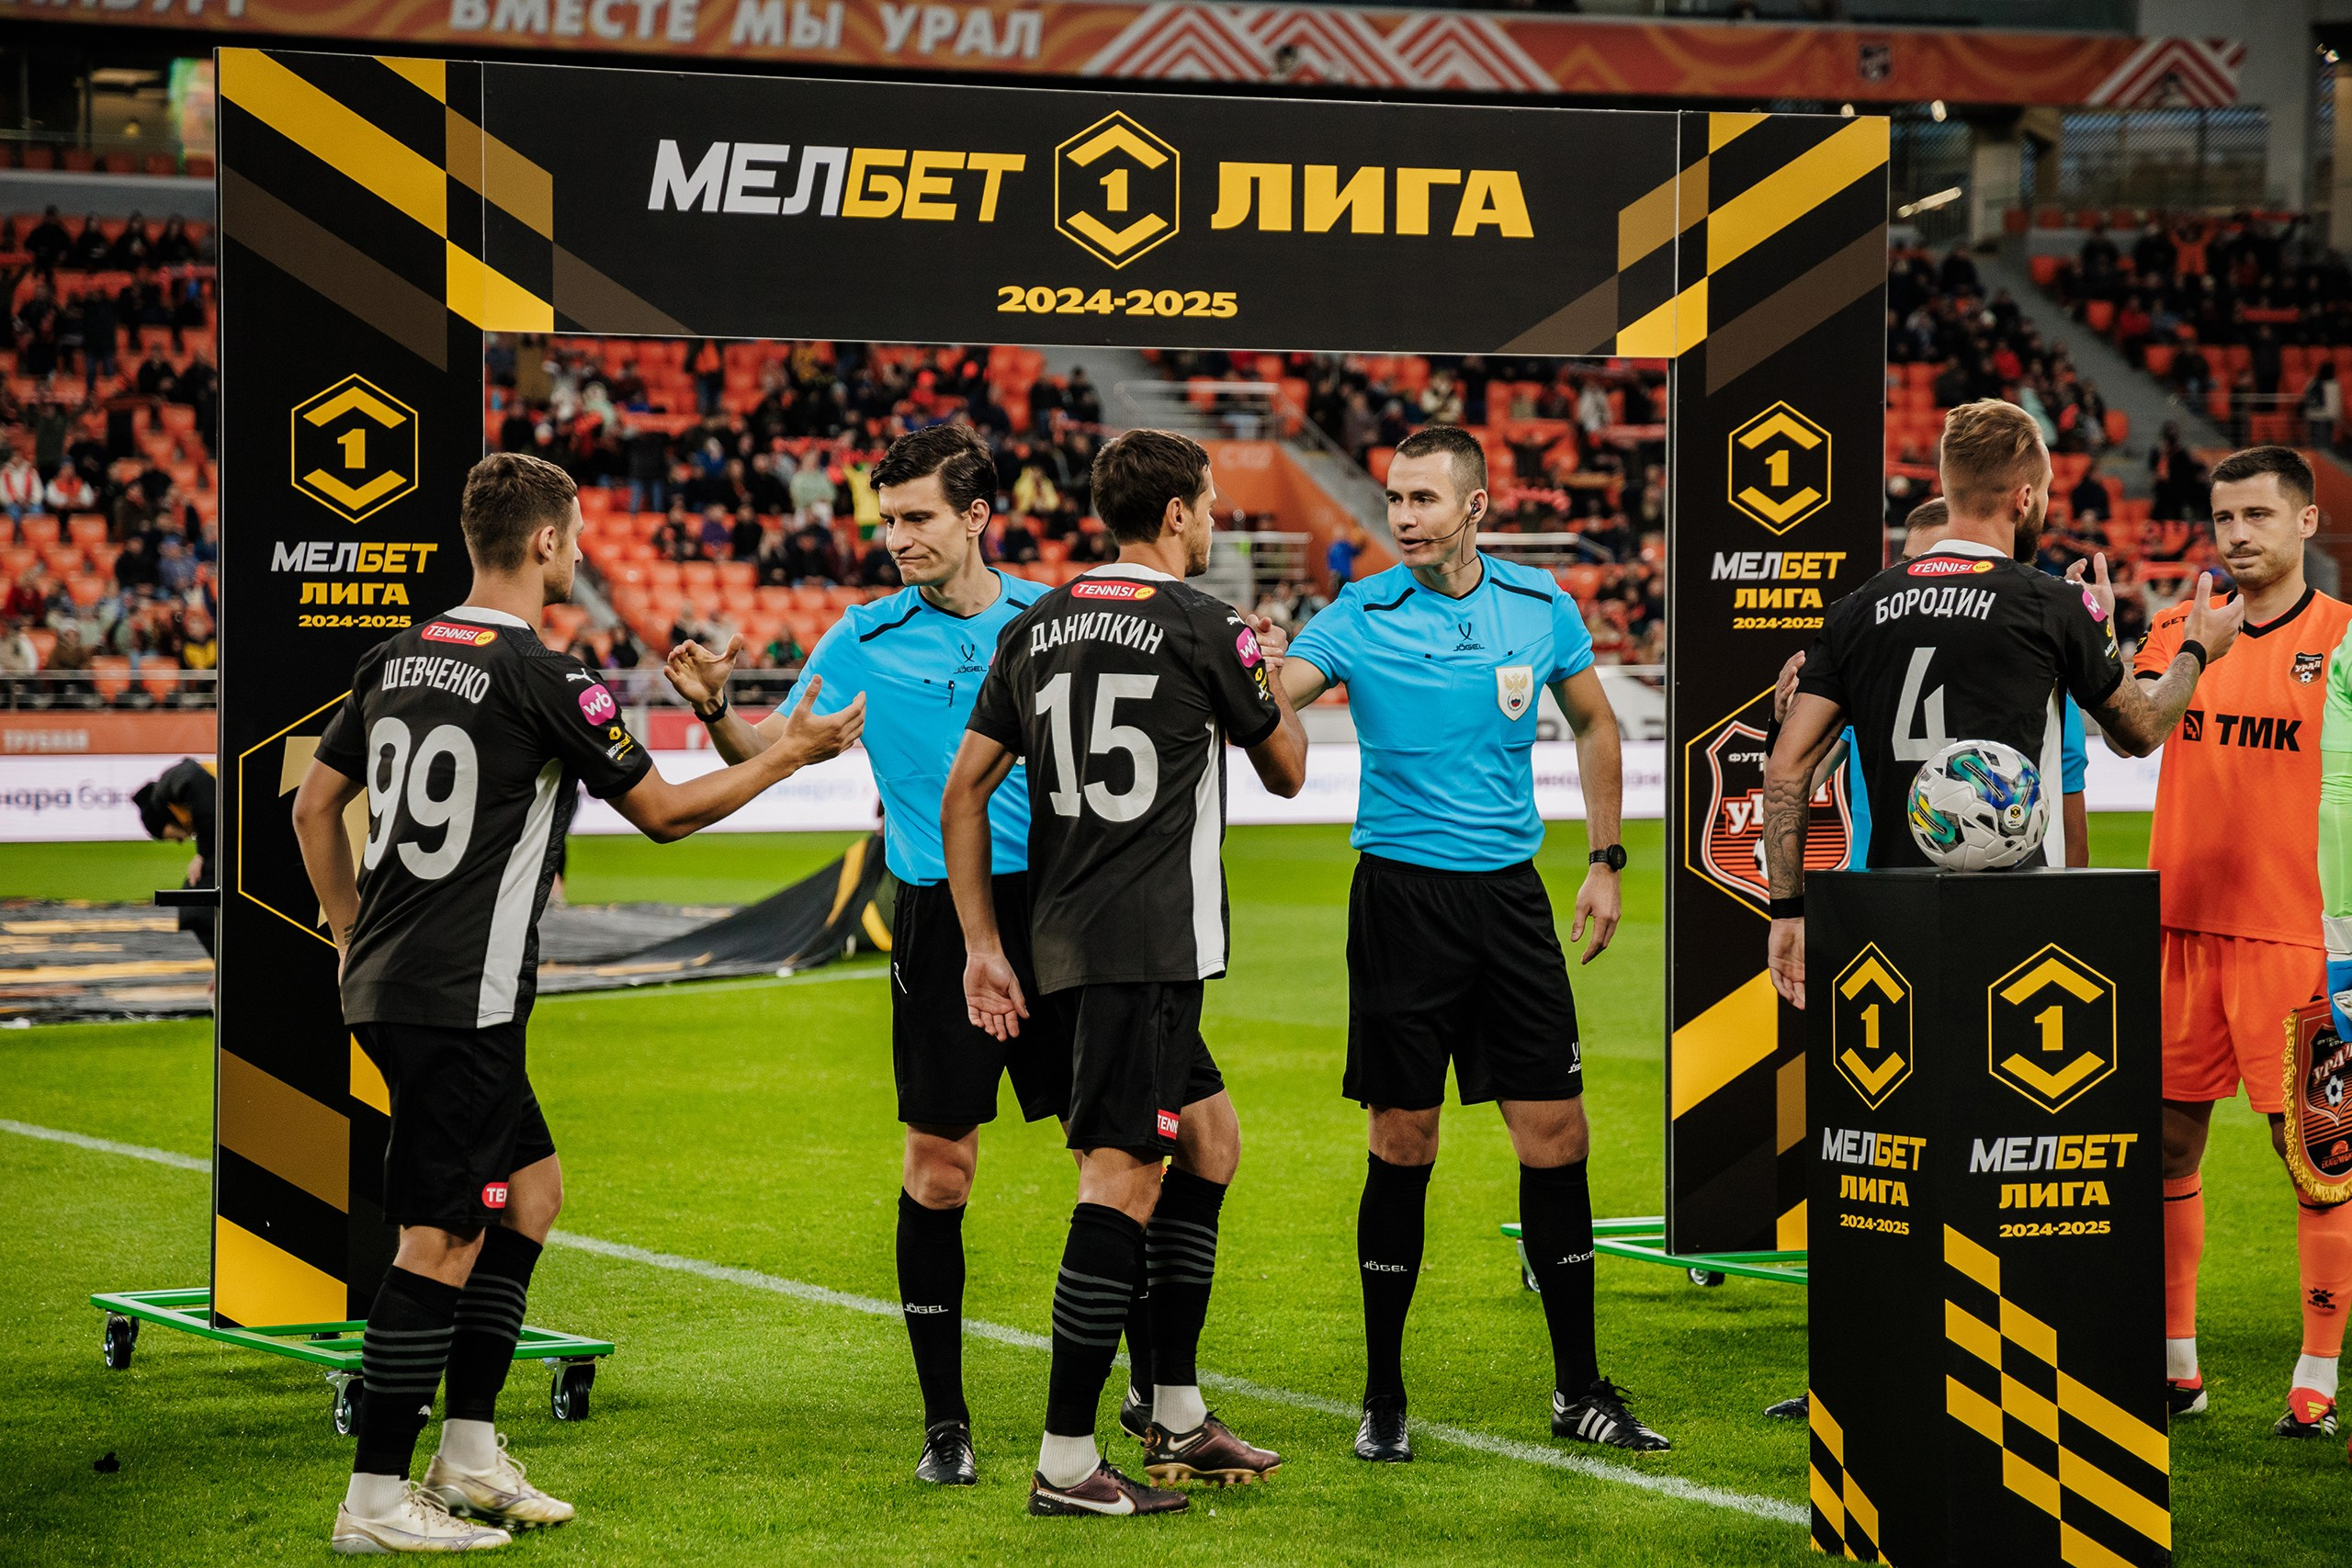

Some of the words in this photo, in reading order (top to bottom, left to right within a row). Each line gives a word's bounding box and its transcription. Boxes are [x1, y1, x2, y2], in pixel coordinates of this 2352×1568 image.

[449, 0, 696, 41] ВМЕСТЕ
[730, 0, 844, 51] МЫ
[879, 5, 1045, 59] УРАЛ
[648, 139, 1026, 222] МЕЛБЕТ
[1100, 168, 1128, 211] 1
[1211, 162, 1534, 238] ЛИГА
[997, 286, 1238, 318] 2024-2025
[336, 428, 366, 468] 1
[1765, 449, 1789, 487] 1
[271, 541, 438, 573] МЕЛБЕТ
[1711, 551, 1847, 581] МЕЛБЕТ
[1914, 561, 1973, 573] TENNISI
[300, 582, 410, 605] ЛИГА
[1078, 584, 1135, 597] TENNISI
[1734, 588, 1824, 609] ЛИГА
[1875, 587, 1996, 625] БОРОДИН
[299, 615, 412, 628] 2024-2025
[426, 626, 479, 641] TENNISI
[1030, 612, 1164, 657] ДАНИЛКИН
[1733, 616, 1825, 629] 2024-2025
[1453, 643, 1485, 651] JÖGEL
[381, 656, 491, 705] ШЕВЧЕНКО
[953, 665, 988, 674] JÖGEL
[582, 692, 612, 716] wb
[1892, 647, 1958, 761] 4
[1035, 672, 1159, 822] 15
[2215, 714, 2302, 752] ТМК
[364, 716, 479, 880] 99
[1860, 1004, 1879, 1049] 1
[2034, 1005, 2064, 1051] 1
[1158, 1114, 1179, 1134] TENN
[1822, 1127, 1927, 1171] МЕЛБЕТ
[1969, 1134, 2138, 1173] МЕЛБЕТ
[1839, 1174, 1909, 1207] ЛИГА
[1999, 1180, 2110, 1209] ЛИГА
[1840, 1213, 1910, 1235] 2024-2025
[1999, 1221, 2111, 1237] 2024-2025
[1363, 1260, 1408, 1272] JÖGEL
[1556, 1249, 1595, 1265] JÖGE
[904, 1303, 949, 1314] JÖGEL
